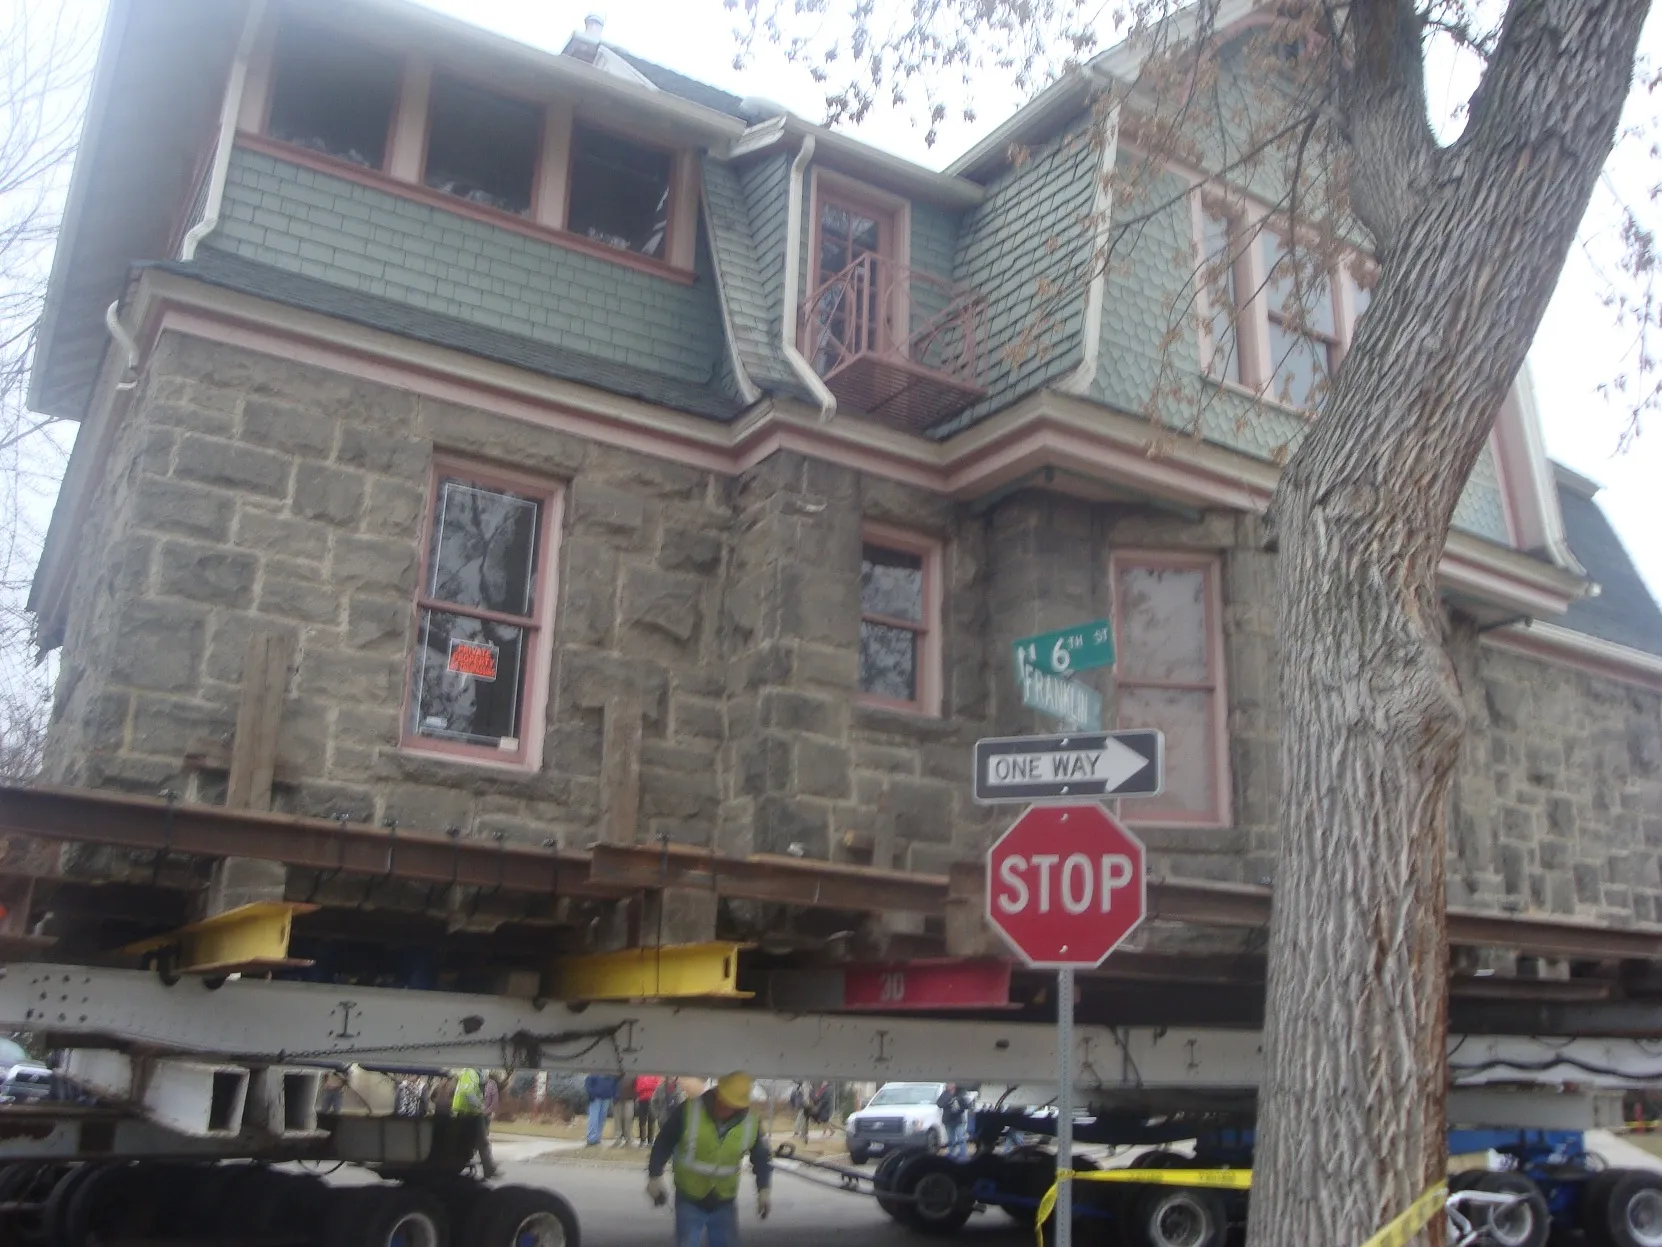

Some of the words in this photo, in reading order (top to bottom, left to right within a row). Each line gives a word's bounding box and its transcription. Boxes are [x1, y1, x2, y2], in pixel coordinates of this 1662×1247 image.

[1093, 627, 1108, 645] ST
[452, 652, 495, 667] PROPERTY
[458, 644, 492, 658] PRIVATE
[1024, 664, 1088, 725] FRANKLIN
[995, 756, 1042, 780] ONE
[1052, 752, 1101, 778] WAY
[998, 853, 1134, 915] STOP
